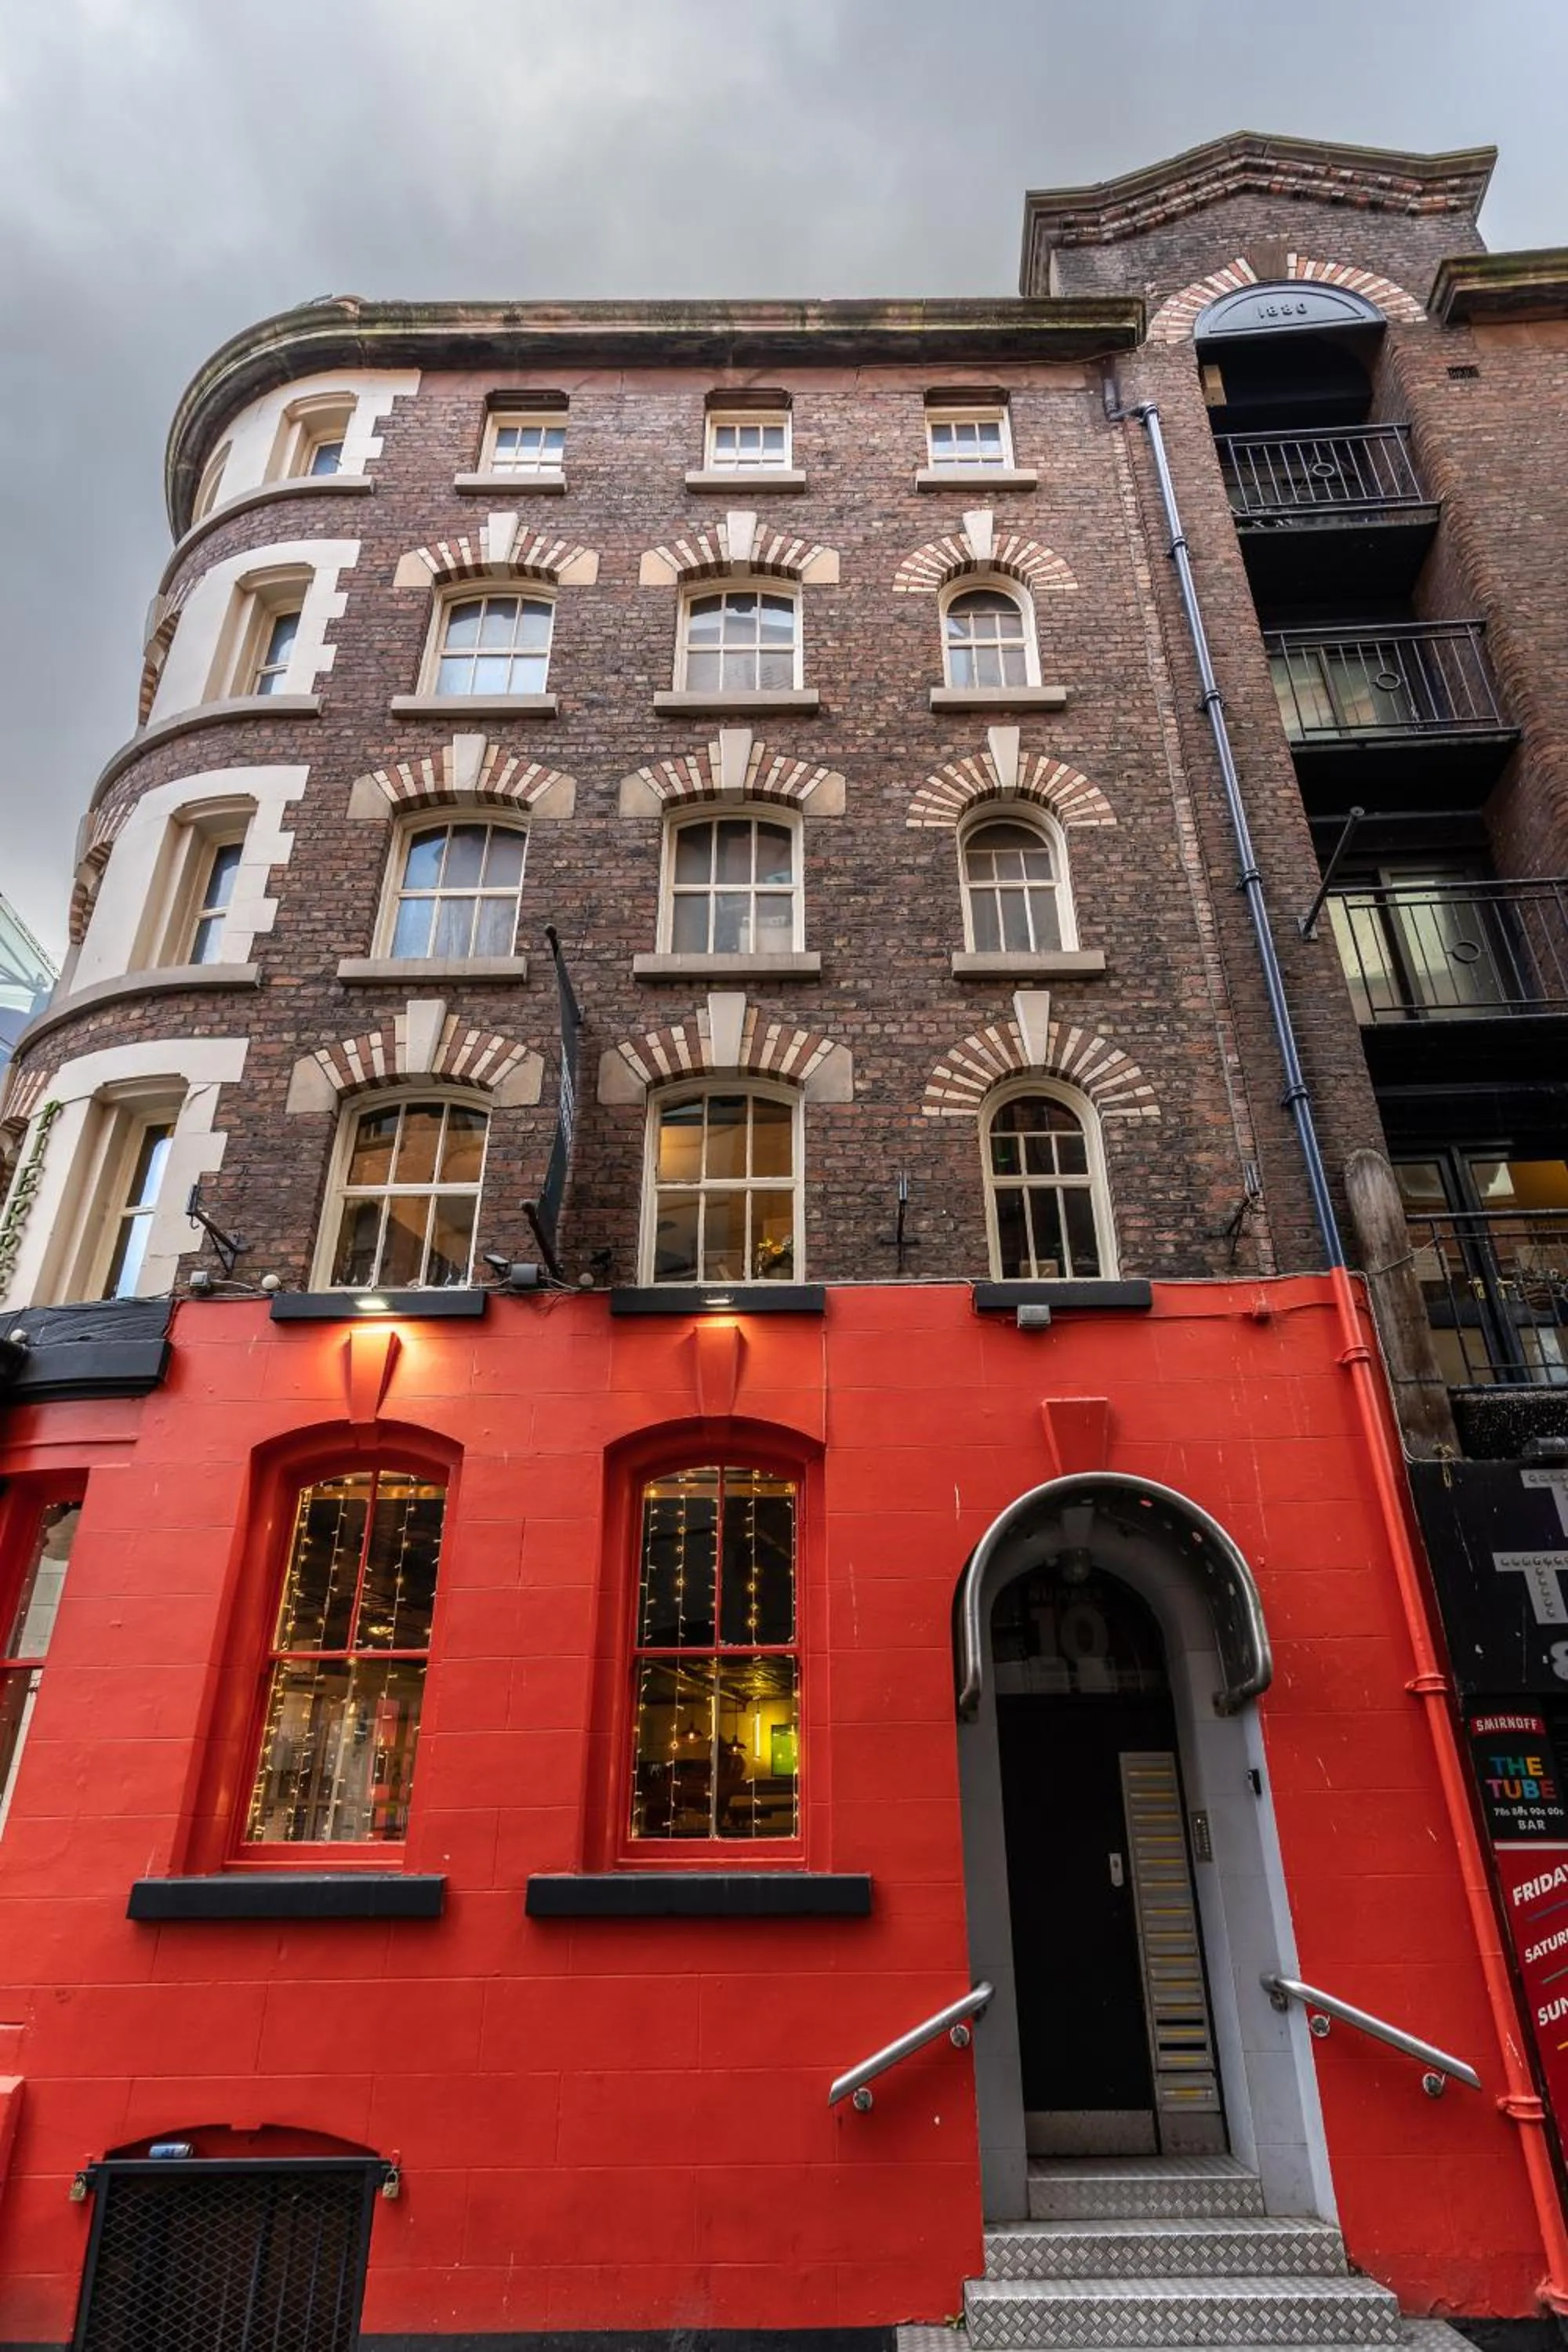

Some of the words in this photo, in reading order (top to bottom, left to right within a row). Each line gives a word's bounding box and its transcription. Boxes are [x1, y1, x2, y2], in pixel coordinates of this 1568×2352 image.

[1029, 1606, 1109, 1661] 10
[1476, 1716, 1537, 1732] SMIRNOFF
[1490, 1756, 1544, 1776] THE
[1486, 1779, 1556, 1799] TUBE
[1517, 1820, 1546, 1831] BAR
